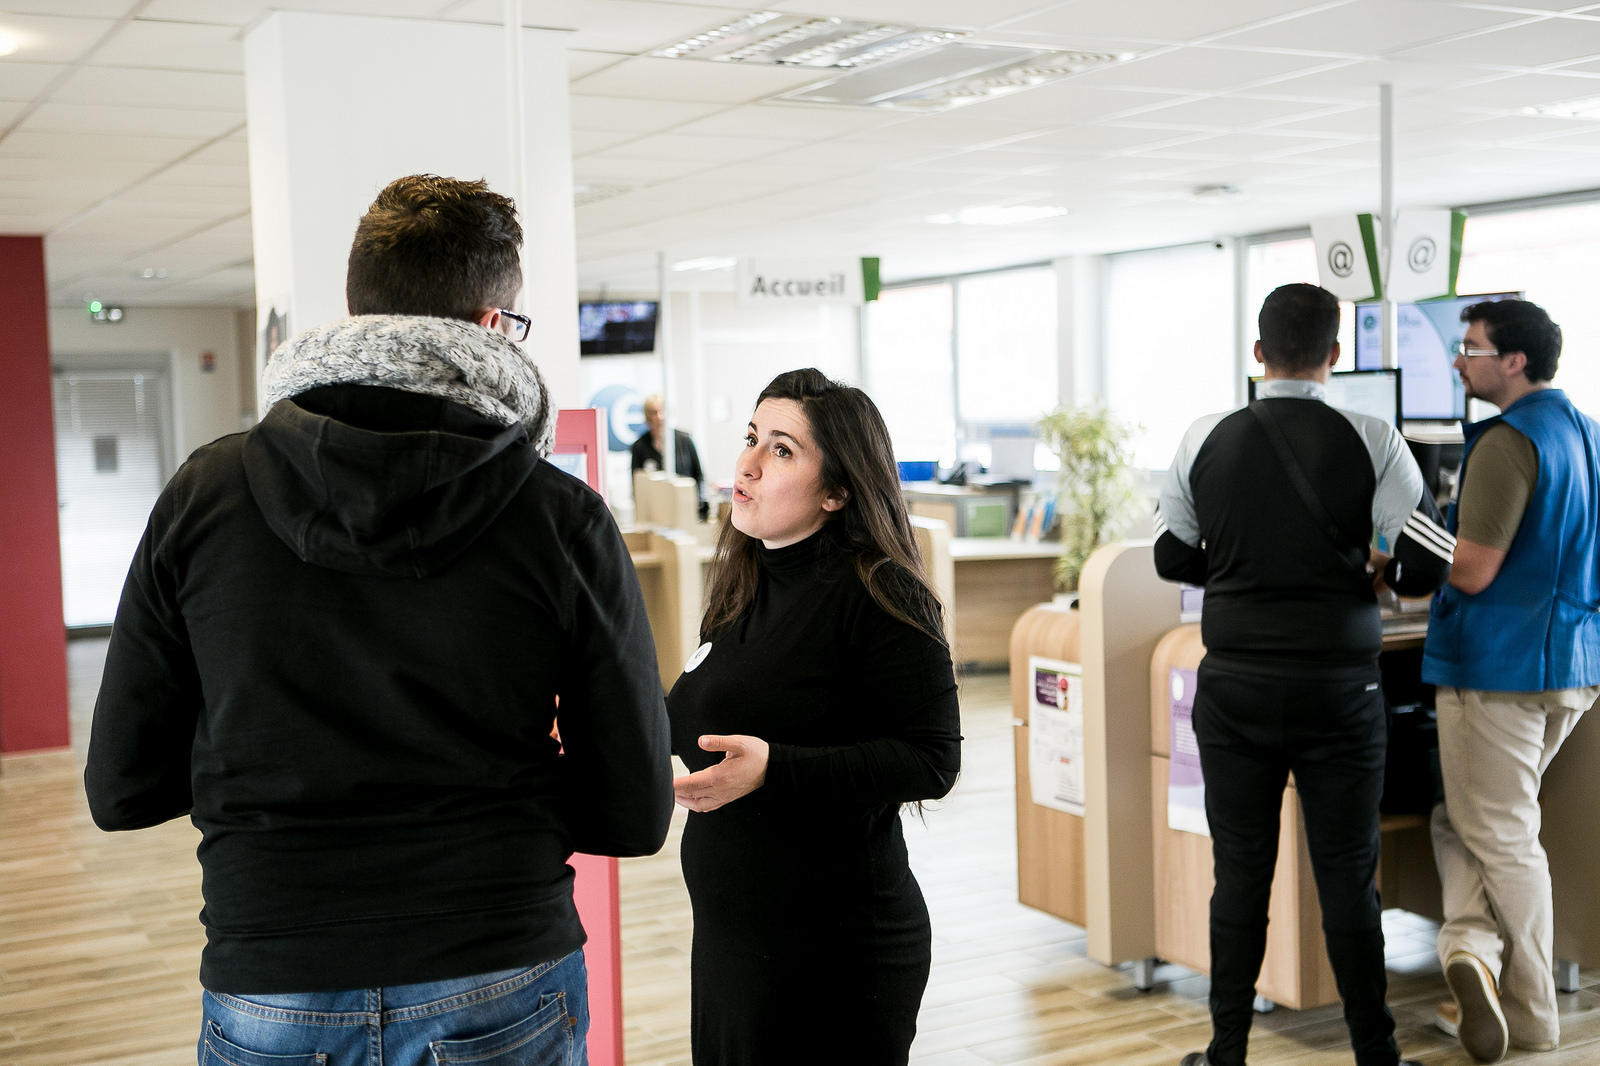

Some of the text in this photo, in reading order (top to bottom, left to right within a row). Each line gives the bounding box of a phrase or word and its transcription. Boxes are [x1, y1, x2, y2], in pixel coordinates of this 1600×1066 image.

[1329, 243, 1354, 277] @
[1408, 237, 1436, 273] @
[752, 273, 845, 296] Accueil
